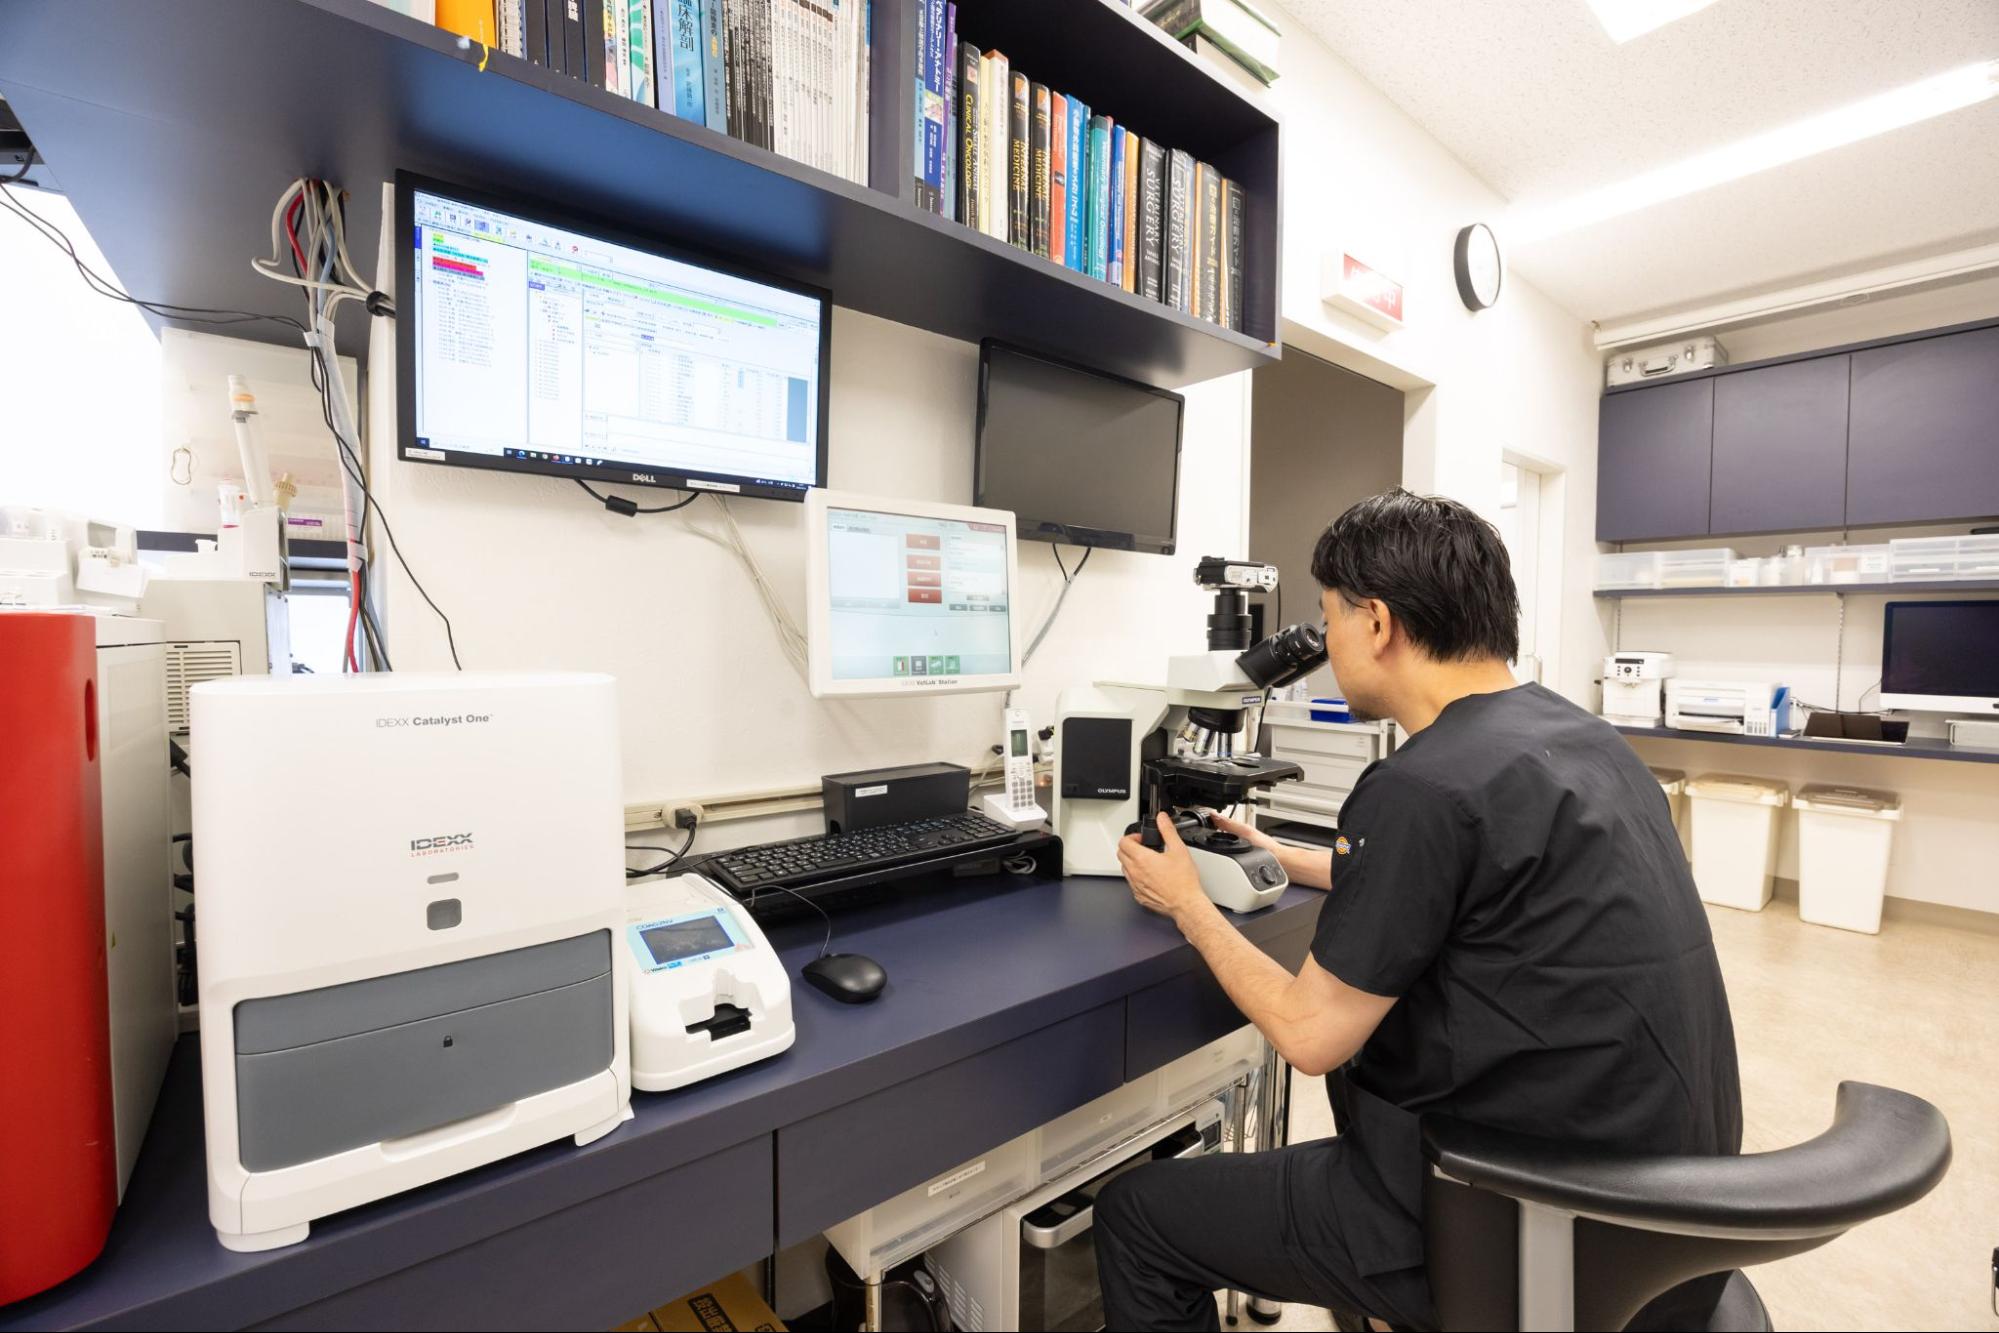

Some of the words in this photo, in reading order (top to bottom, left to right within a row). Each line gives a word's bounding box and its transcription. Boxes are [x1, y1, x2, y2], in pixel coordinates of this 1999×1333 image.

[965, 93, 973, 134] CLINICAL
[965, 137, 974, 189] ONCOLOGY
[1034, 148, 1042, 200] MEDICINE
[1098, 183, 1107, 219] Surgical
[1145, 167, 1155, 248] SURGERY
[1153, 177, 1161, 245] VETERINARY
[1172, 179, 1181, 257] SURGERY
[1097, 219, 1106, 259] Oncology
[632, 473, 656, 483] DELL
[376, 717, 410, 729] IDEXX
[412, 713, 463, 728] Catalyst
[466, 712, 490, 724] One
[410, 832, 473, 852] IDEXX
[411, 844, 475, 857] LABORATORIES
